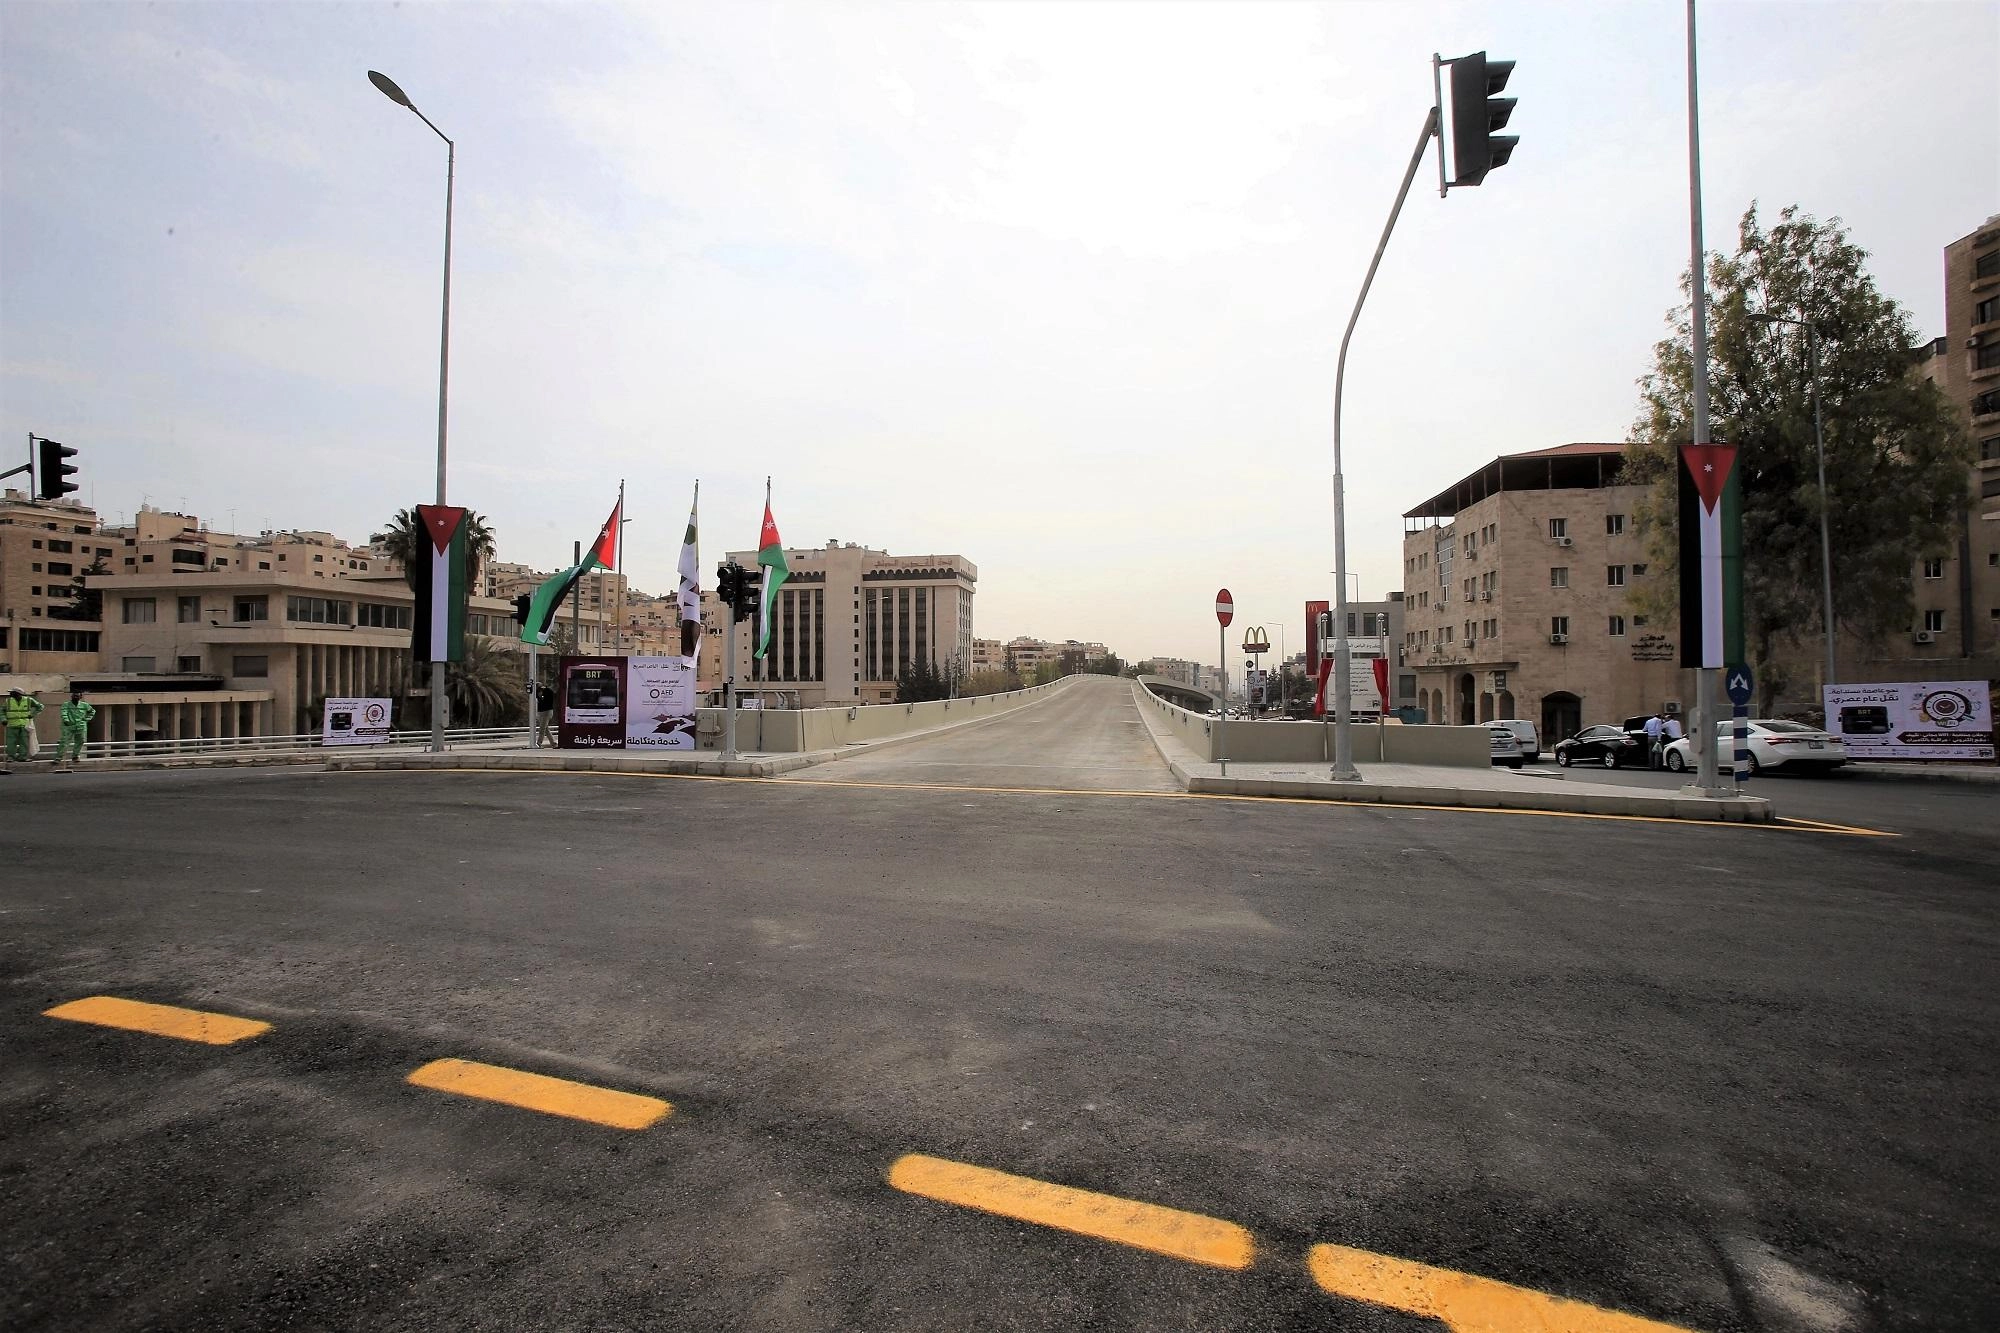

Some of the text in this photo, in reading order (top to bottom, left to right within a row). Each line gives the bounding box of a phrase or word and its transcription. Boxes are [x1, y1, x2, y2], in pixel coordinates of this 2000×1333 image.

[586, 671, 602, 679] BRT
[728, 676, 734, 685] 2
[1863, 695, 1879, 703] عام
[1880, 694, 1899, 702] نقل
[574, 735, 681, 747] خدمة متكاملة سريعة وآمنة
